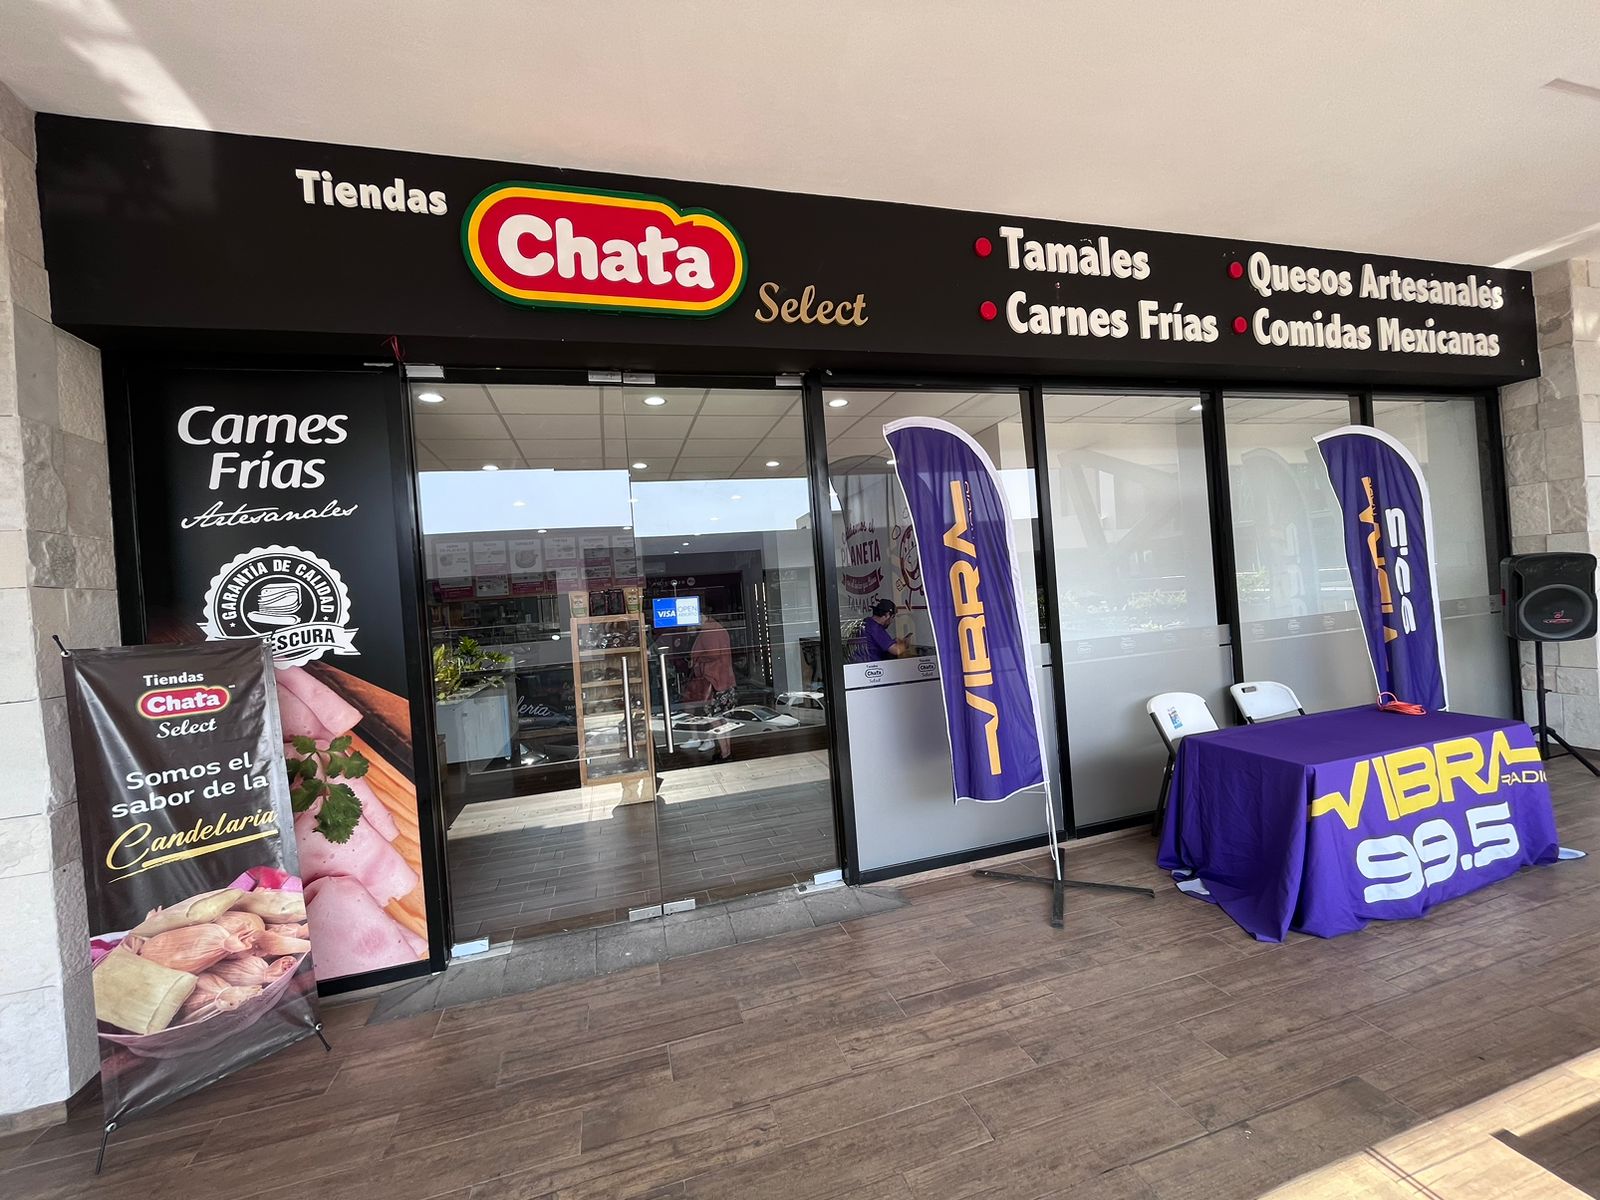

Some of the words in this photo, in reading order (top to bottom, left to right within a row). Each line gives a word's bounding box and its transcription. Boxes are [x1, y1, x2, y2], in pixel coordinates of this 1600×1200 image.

[295, 169, 447, 215] Tiendas
[497, 213, 715, 290] Chata
[999, 226, 1151, 280] Tamales
[1246, 252, 1353, 298] Quesos
[1359, 263, 1504, 310] Artesanales
[754, 282, 868, 327] Select
[1006, 290, 1129, 338] Carnes
[1138, 299, 1218, 343] Frías
[1251, 308, 1371, 350] Comidas
[1377, 316, 1500, 357] Mexicanas
[177, 405, 348, 445] Carnes
[209, 450, 326, 490] Frías
[181, 499, 358, 529] Artesanales
[221, 561, 269, 621] GARANTÍA
[273, 559, 292, 573] DE
[295, 563, 335, 613] CALIDAD
[657, 609, 676, 618] VISA
[943, 480, 1003, 776] VIBRA
[143, 672, 204, 687] Tiendas
[146, 691, 221, 714] Chata
[156, 718, 217, 739] Select
[126, 759, 221, 790] Somos
[228, 752, 252, 771] el
[1309, 730, 1542, 830] VIBRA
[112, 789, 195, 818] sabor
[202, 780, 236, 799] de
[243, 773, 269, 791] la
[106, 808, 278, 870] Candelaria
[1356, 802, 1520, 904] 99.5
